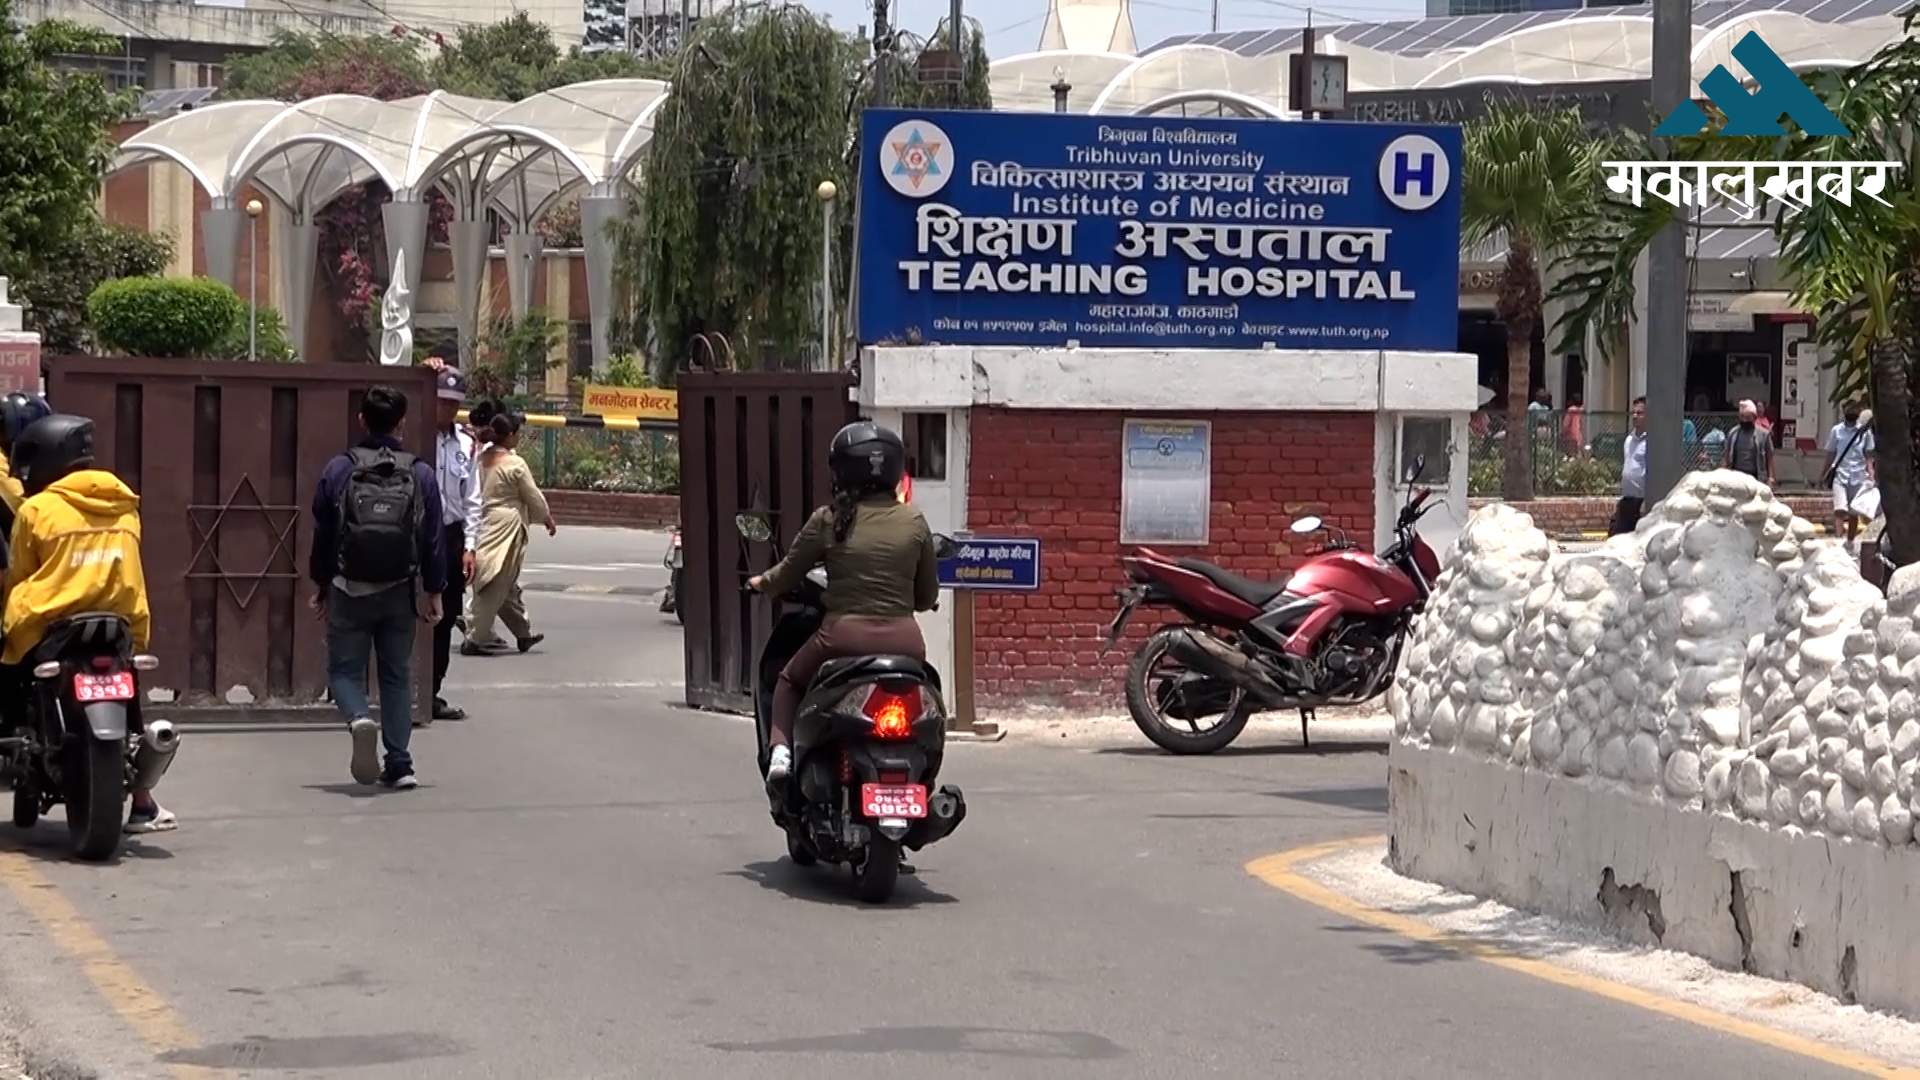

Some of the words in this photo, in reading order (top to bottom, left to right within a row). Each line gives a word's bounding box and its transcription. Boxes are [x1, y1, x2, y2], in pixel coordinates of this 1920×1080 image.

[1098, 125, 1147, 146] त्रिभुवन
[1065, 145, 1162, 164] Tribhuvan
[1168, 149, 1265, 172] University
[1394, 152, 1435, 196] H
[971, 160, 1145, 192] चिकित्साशास्त्र
[1153, 171, 1255, 193] अध्ययन
[1263, 171, 1351, 196] संस्थान
[1012, 192, 1139, 216] Institute
[1149, 196, 1181, 217] of
[1189, 196, 1325, 221] Medicine
[916, 202, 1078, 260] शिक्षण
[1115, 219, 1392, 263] अस्पताल
[899, 260, 1149, 295] TEACHING
[1187, 266, 1416, 300] HOSPITAL
[1075, 321, 1236, 337] hospital.info@tuth.org.np
[1288, 325, 1390, 340] www.tuth.org.np
